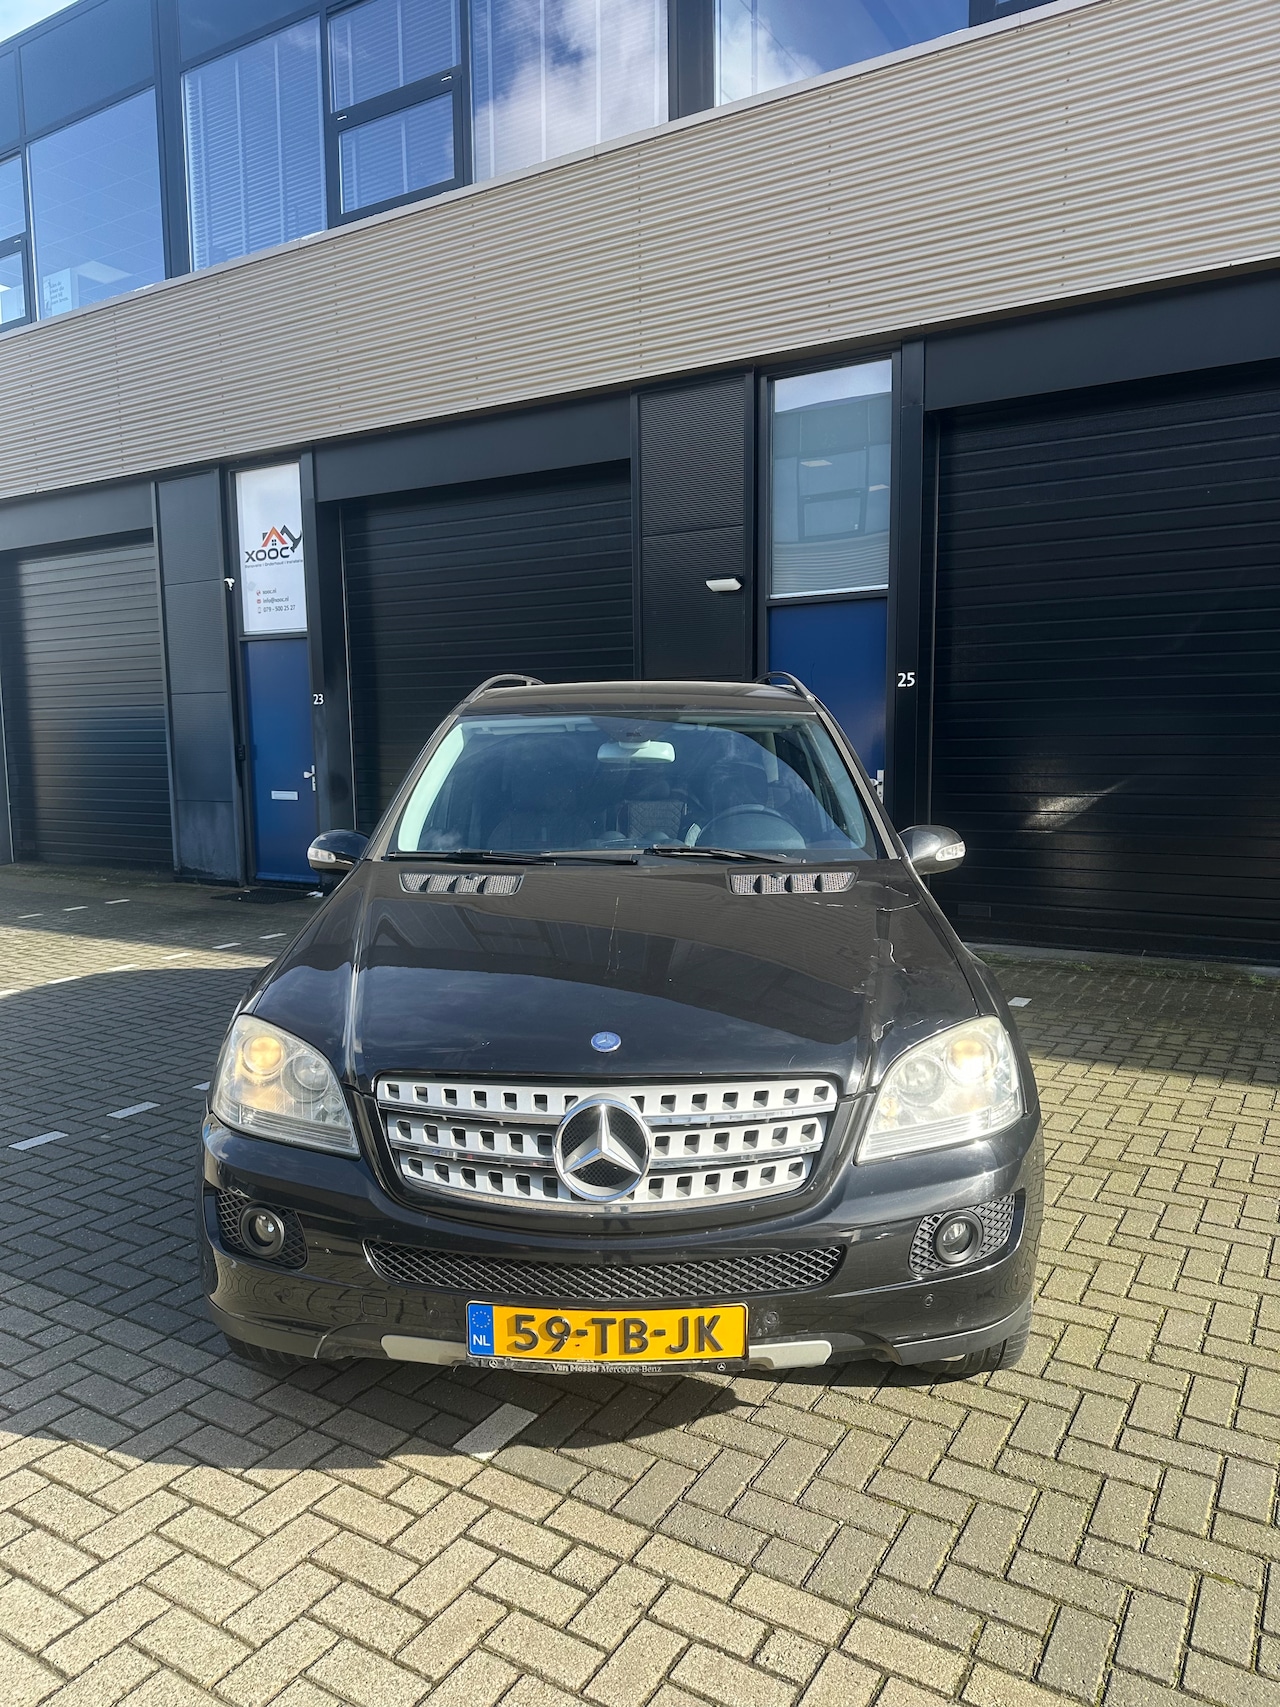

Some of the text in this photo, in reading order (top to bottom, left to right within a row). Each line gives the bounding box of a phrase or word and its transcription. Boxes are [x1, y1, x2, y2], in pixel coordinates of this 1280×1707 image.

[897, 672, 915, 687] 25
[313, 693, 324, 705] 23
[473, 1334, 491, 1346] NL
[507, 1314, 723, 1354] 59-TB-JK
[552, 1363, 662, 1374] Van Mossel Mercedes-Benz
